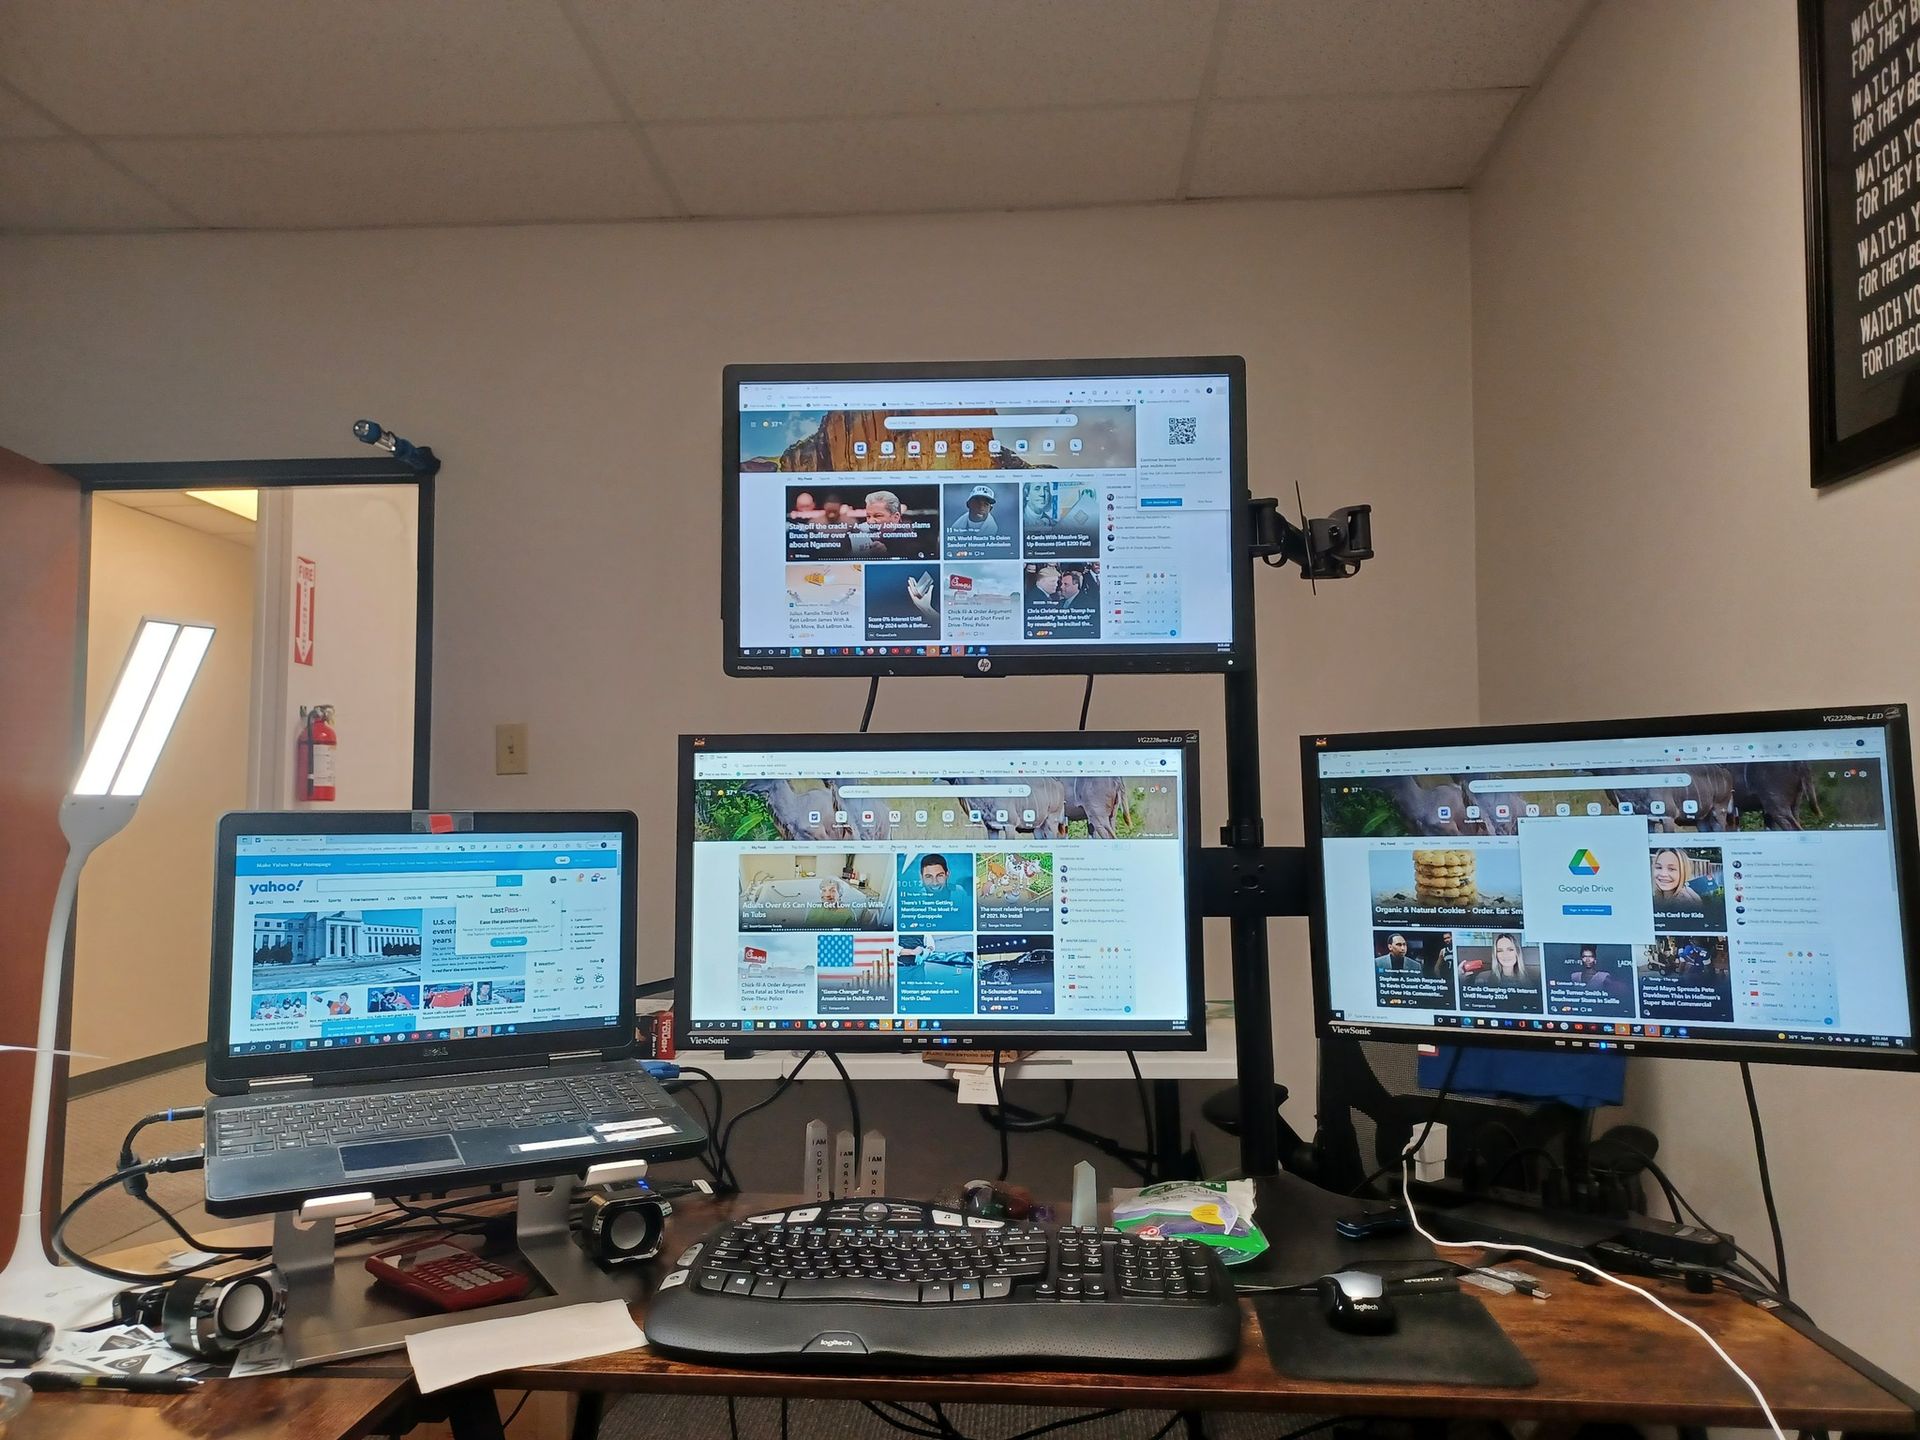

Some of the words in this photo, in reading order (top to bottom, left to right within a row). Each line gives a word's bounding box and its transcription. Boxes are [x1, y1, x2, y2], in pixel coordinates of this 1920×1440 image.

[1852, 38, 1874, 78] FOR
[1878, 4, 1907, 54] THEY
[1852, 57, 1899, 120] WATCH
[1853, 112, 1874, 152] FOR
[1876, 84, 1905, 132] THEY
[1856, 135, 1900, 192] WATCH
[1856, 186, 1879, 224] FOR
[1882, 159, 1912, 206] THEY
[1858, 212, 1906, 269] WATCH
[1858, 268, 1878, 302] FOR
[1880, 248, 1906, 287] THEY
[1860, 296, 1902, 345] WATCH
[1862, 346, 1883, 379] FOR
[1884, 338, 1894, 368] IT
[298, 565, 313, 581] FIRE
[1822, 713, 1883, 722] VG2228wm-LED
[250, 880, 304, 895] yahoo!
[1558, 885, 1589, 894] Google
[1376, 906, 1402, 915] Organic
[424, 1047, 448, 1056] DELL
[1331, 1026, 1371, 1035] ViewSonic
